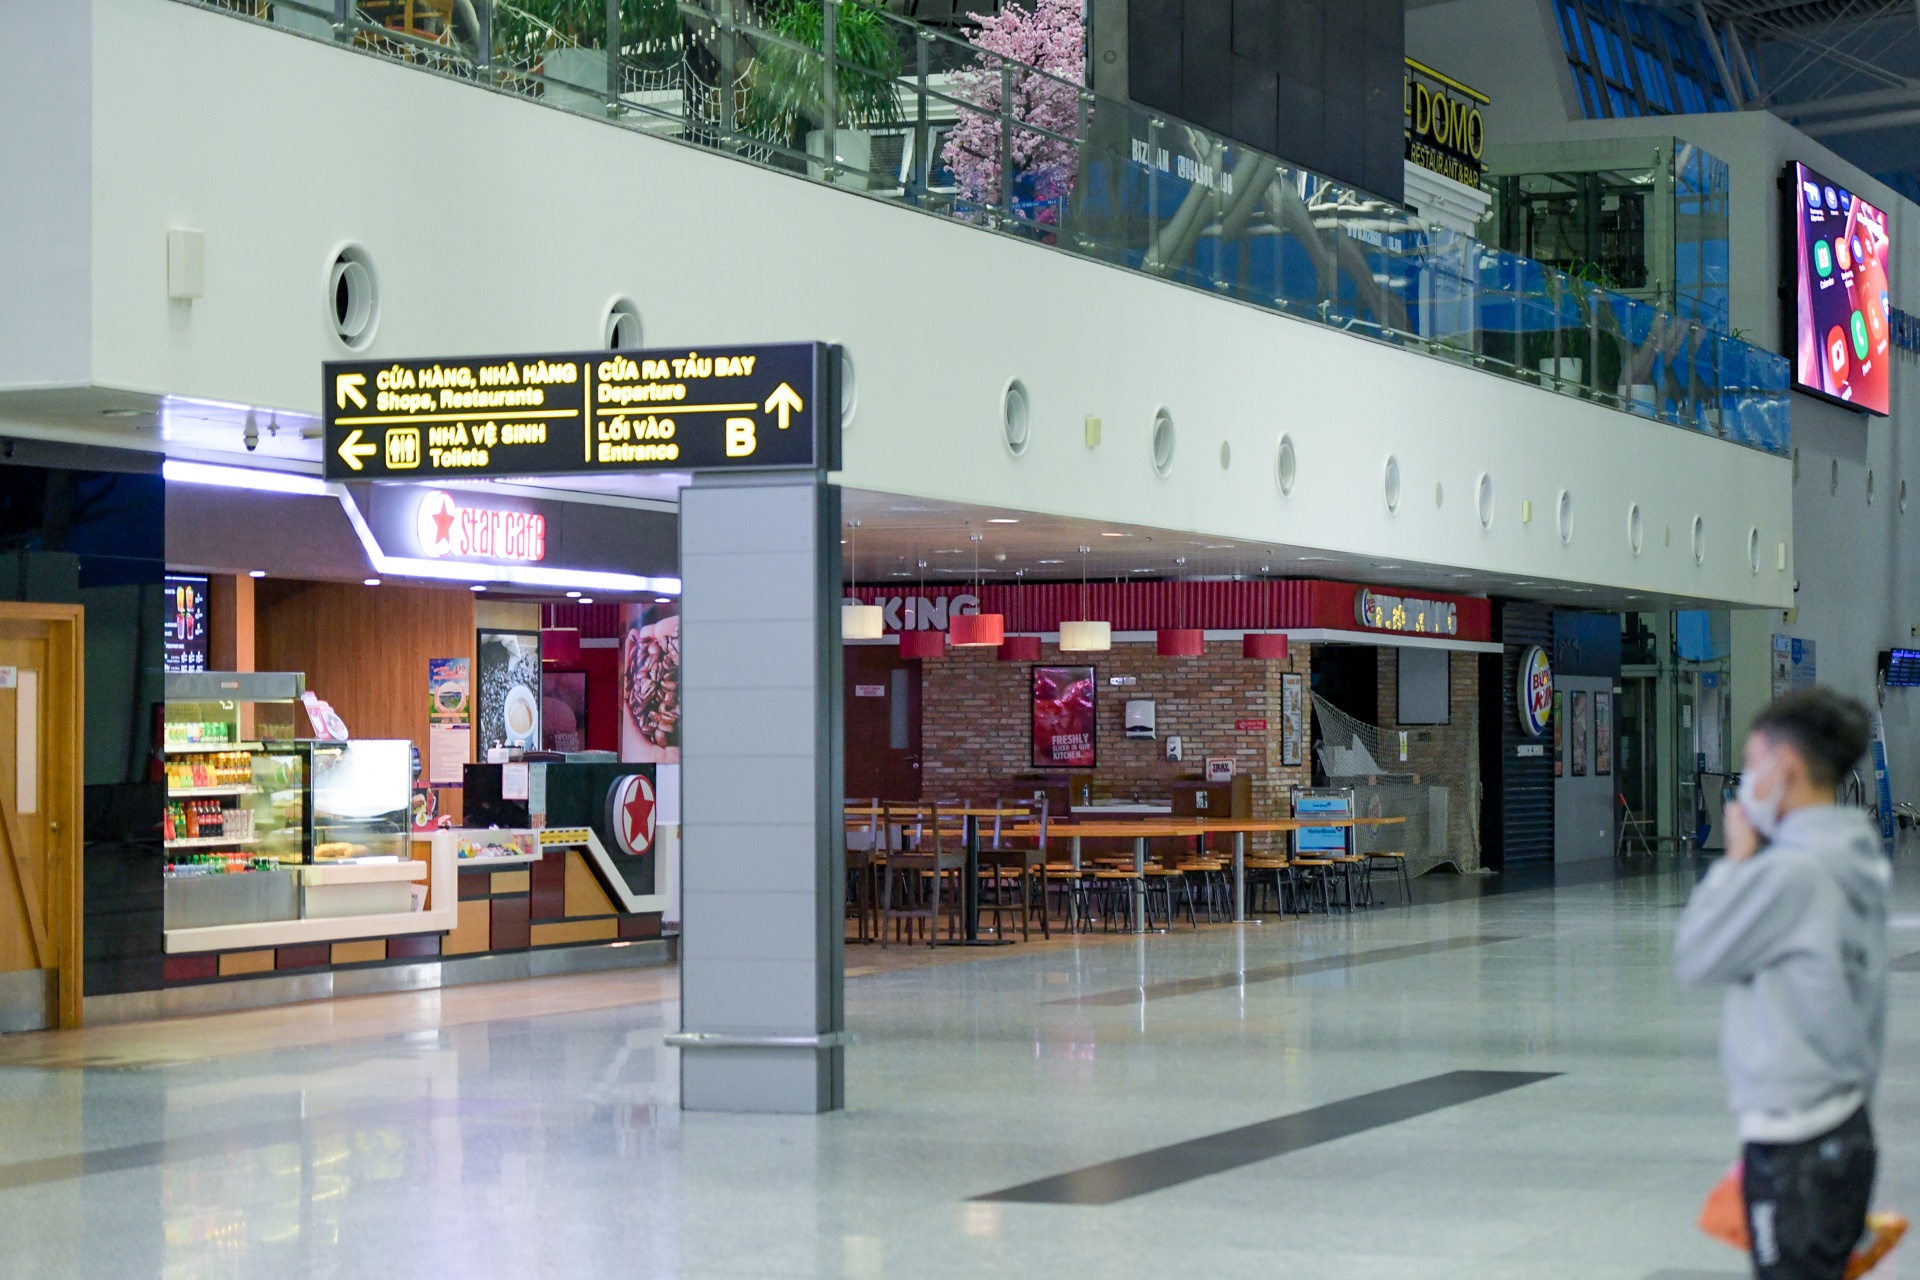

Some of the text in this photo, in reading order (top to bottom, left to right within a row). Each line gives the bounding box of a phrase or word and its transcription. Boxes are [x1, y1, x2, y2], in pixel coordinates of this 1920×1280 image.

[1416, 83, 1484, 159] DOMO
[641, 359, 671, 380] RA
[714, 355, 757, 377] BAY
[376, 386, 545, 413] Shops, Restaurants
[597, 382, 687, 406] Departure
[500, 422, 547, 445] SINH
[725, 417, 757, 457] B
[428, 447, 490, 468] Toilets
[597, 442, 680, 463] Entrance
[460, 507, 500, 556] star
[1052, 733, 1089, 744] FRESHLY
